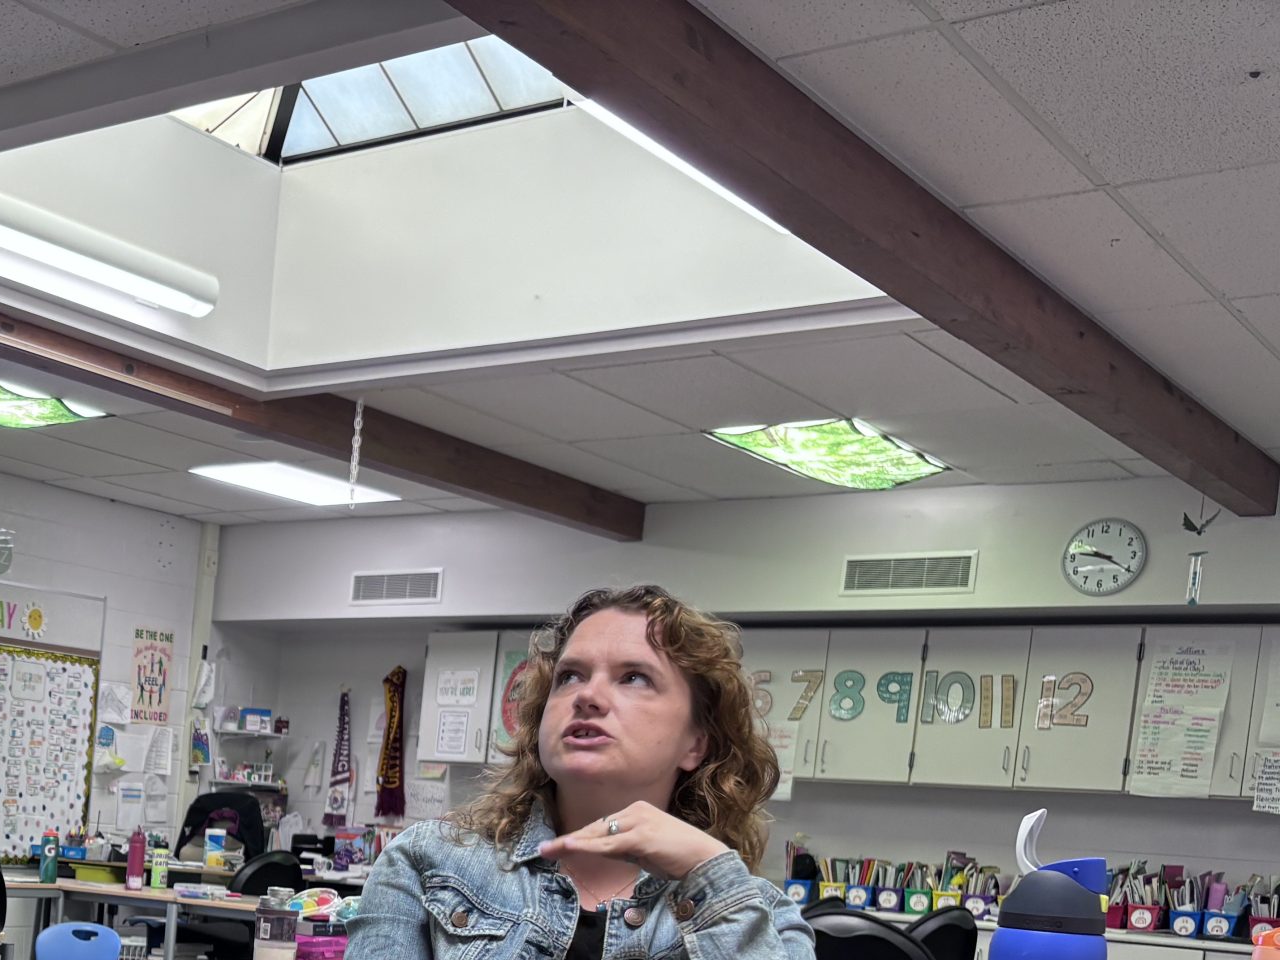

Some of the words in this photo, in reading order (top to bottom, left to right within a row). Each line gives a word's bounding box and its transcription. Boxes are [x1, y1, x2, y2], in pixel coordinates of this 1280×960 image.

[1087, 529, 1095, 538] 11
[1101, 524, 1110, 534] 12
[1127, 537, 1134, 546] 2
[1070, 554, 1076, 563] 9
[1131, 551, 1137, 560] 3
[1083, 576, 1089, 585] 7
[1113, 574, 1119, 584] 5
[135, 629, 144, 639] BE
[146, 630, 157, 641] THE
[159, 632, 174, 643] ONE
[144, 676, 159, 687] FEEL
[787, 669, 824, 721] 7
[828, 669, 866, 721] 8
[877, 671, 914, 723] 9
[920, 670, 976, 725] 10
[979, 674, 1016, 729] 11
[1035, 671, 1094, 730] 12
[130, 709, 168, 722] INCLUDED
[44, 844, 56, 857] G
